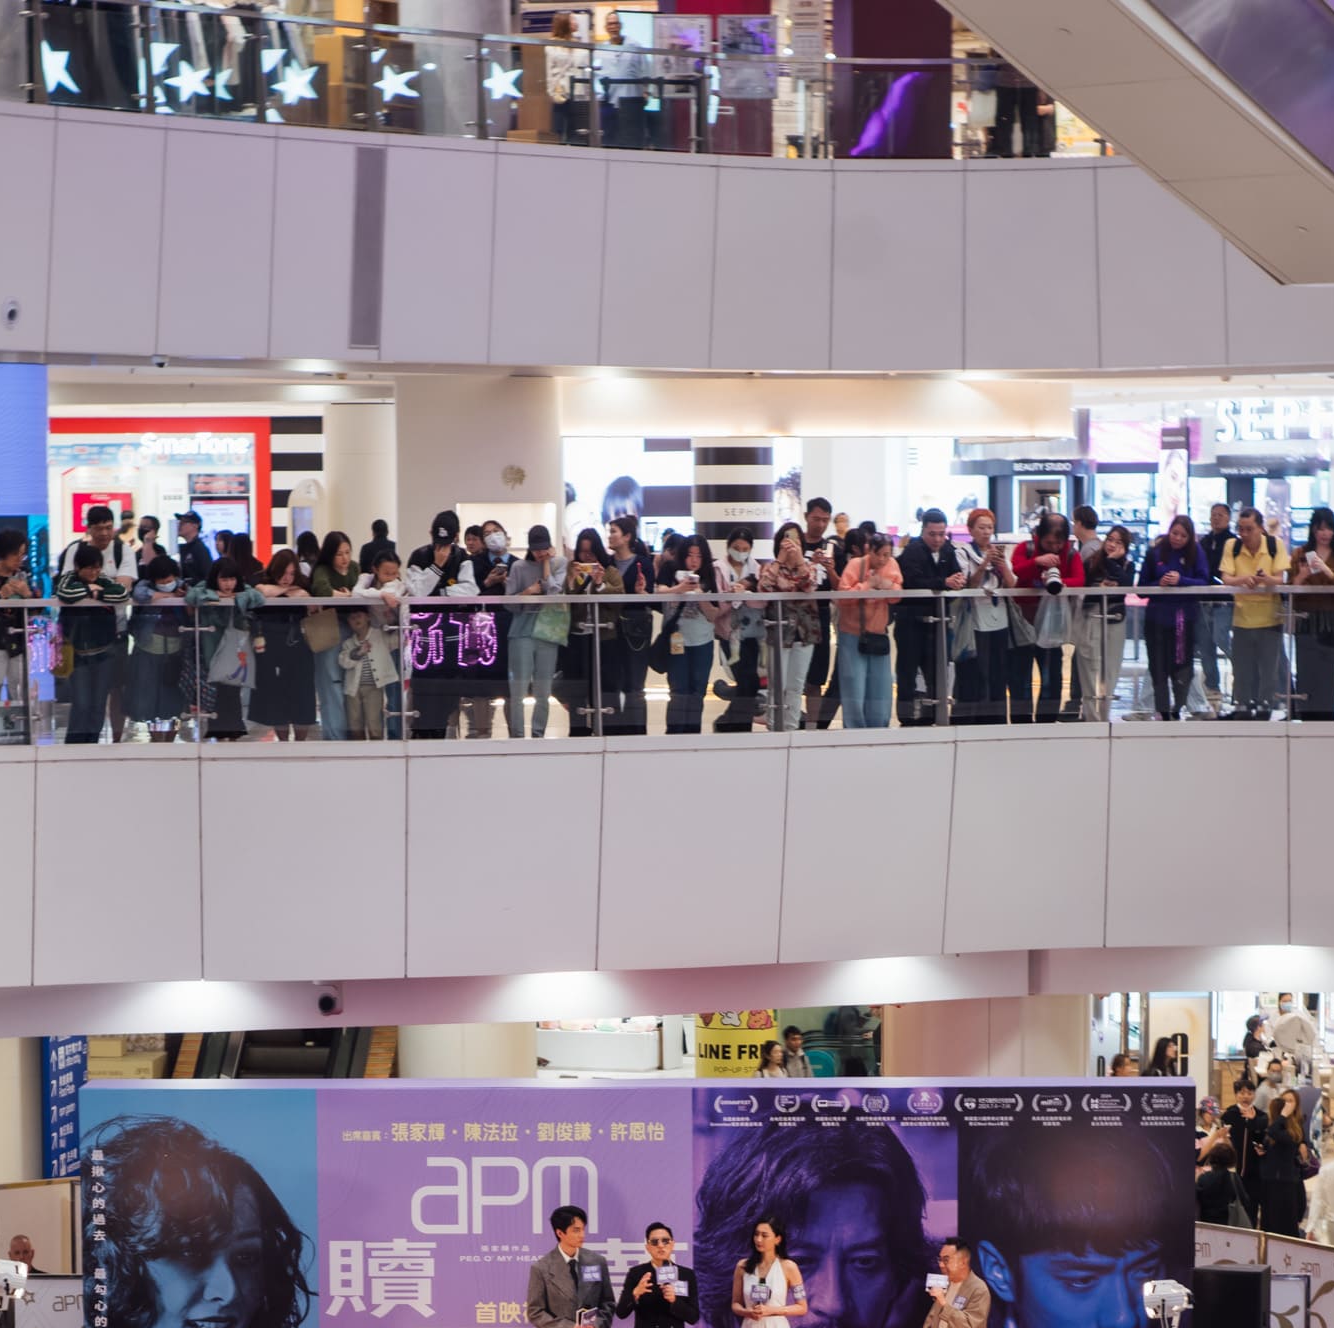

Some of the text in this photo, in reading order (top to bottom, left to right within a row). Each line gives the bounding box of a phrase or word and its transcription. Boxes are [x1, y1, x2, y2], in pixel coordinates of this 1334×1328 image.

[1013, 461, 1073, 472] BEAUTY STUDIO
[698, 1043, 732, 1060] LINE
[411, 1156, 598, 1235] apm
[326, 1239, 437, 1318] 贖
[1300, 1262, 1320, 1278] apm
